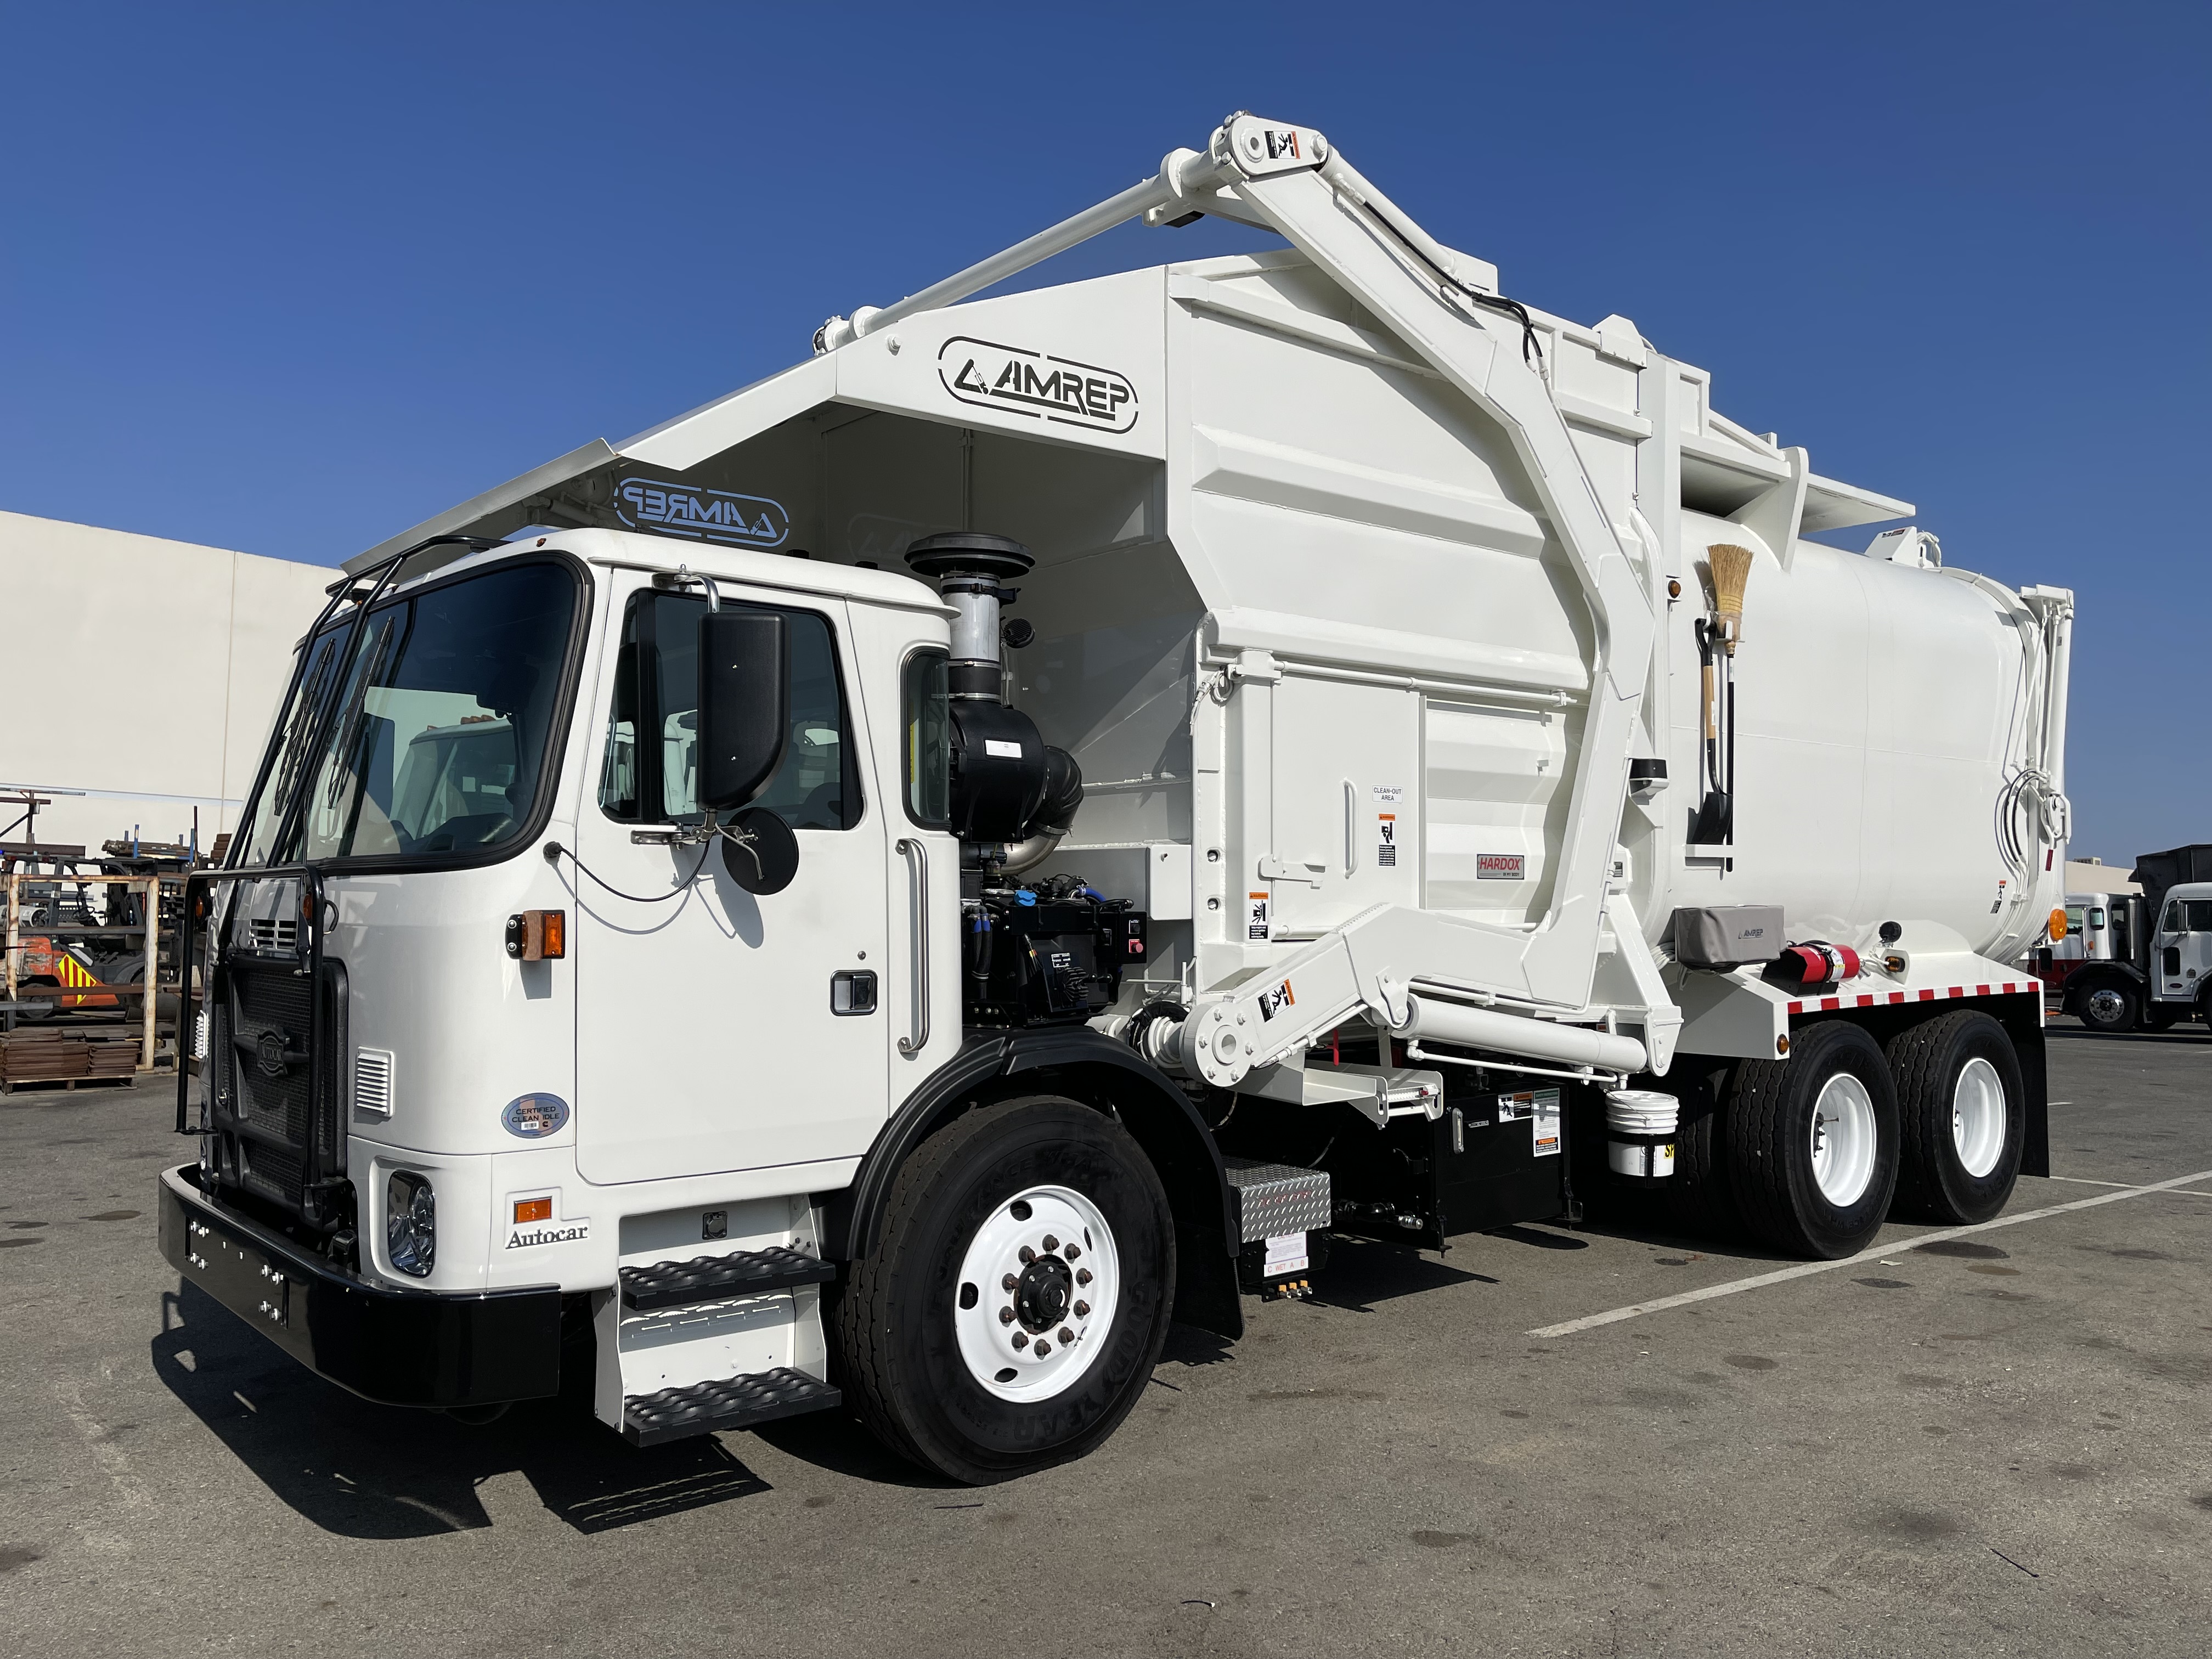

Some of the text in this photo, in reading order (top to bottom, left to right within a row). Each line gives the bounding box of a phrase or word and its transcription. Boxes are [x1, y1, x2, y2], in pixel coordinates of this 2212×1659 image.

[990, 360, 1130, 418] AMREP
[516, 1107, 556, 1115] CERTIFIED
[505, 1227, 588, 1249] Autocar
